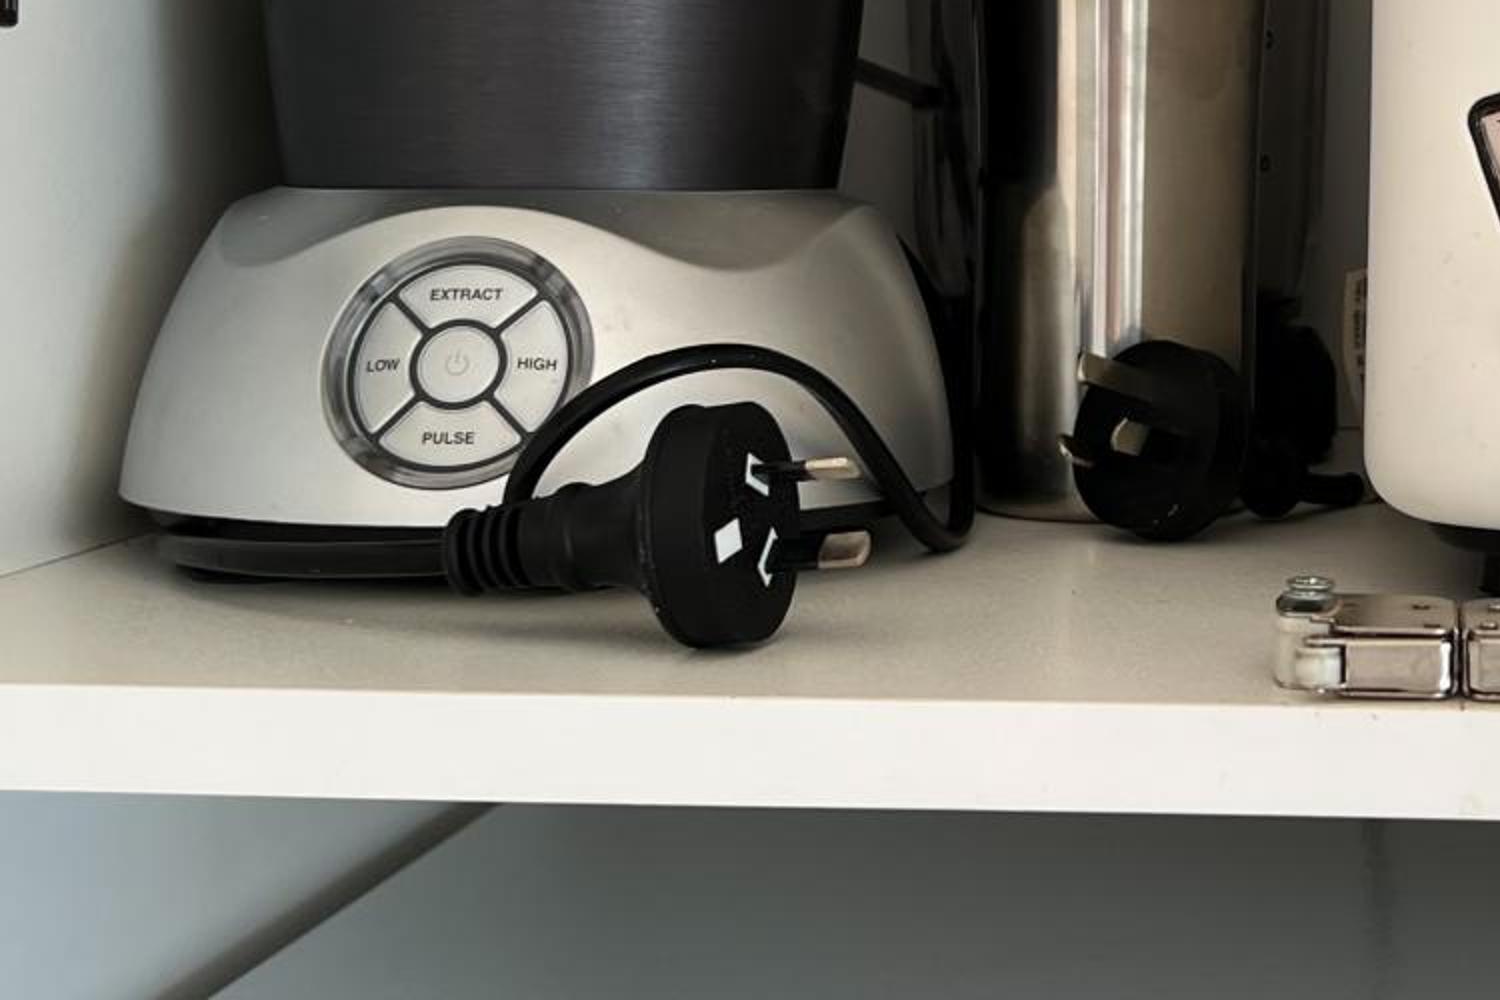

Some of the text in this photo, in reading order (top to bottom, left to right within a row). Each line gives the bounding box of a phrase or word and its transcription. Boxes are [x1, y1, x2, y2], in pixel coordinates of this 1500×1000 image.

[429, 287, 503, 302] EXTRACT
[366, 359, 401, 374] LOW
[516, 356, 557, 371] HIGH
[421, 431, 475, 446] PULSE
